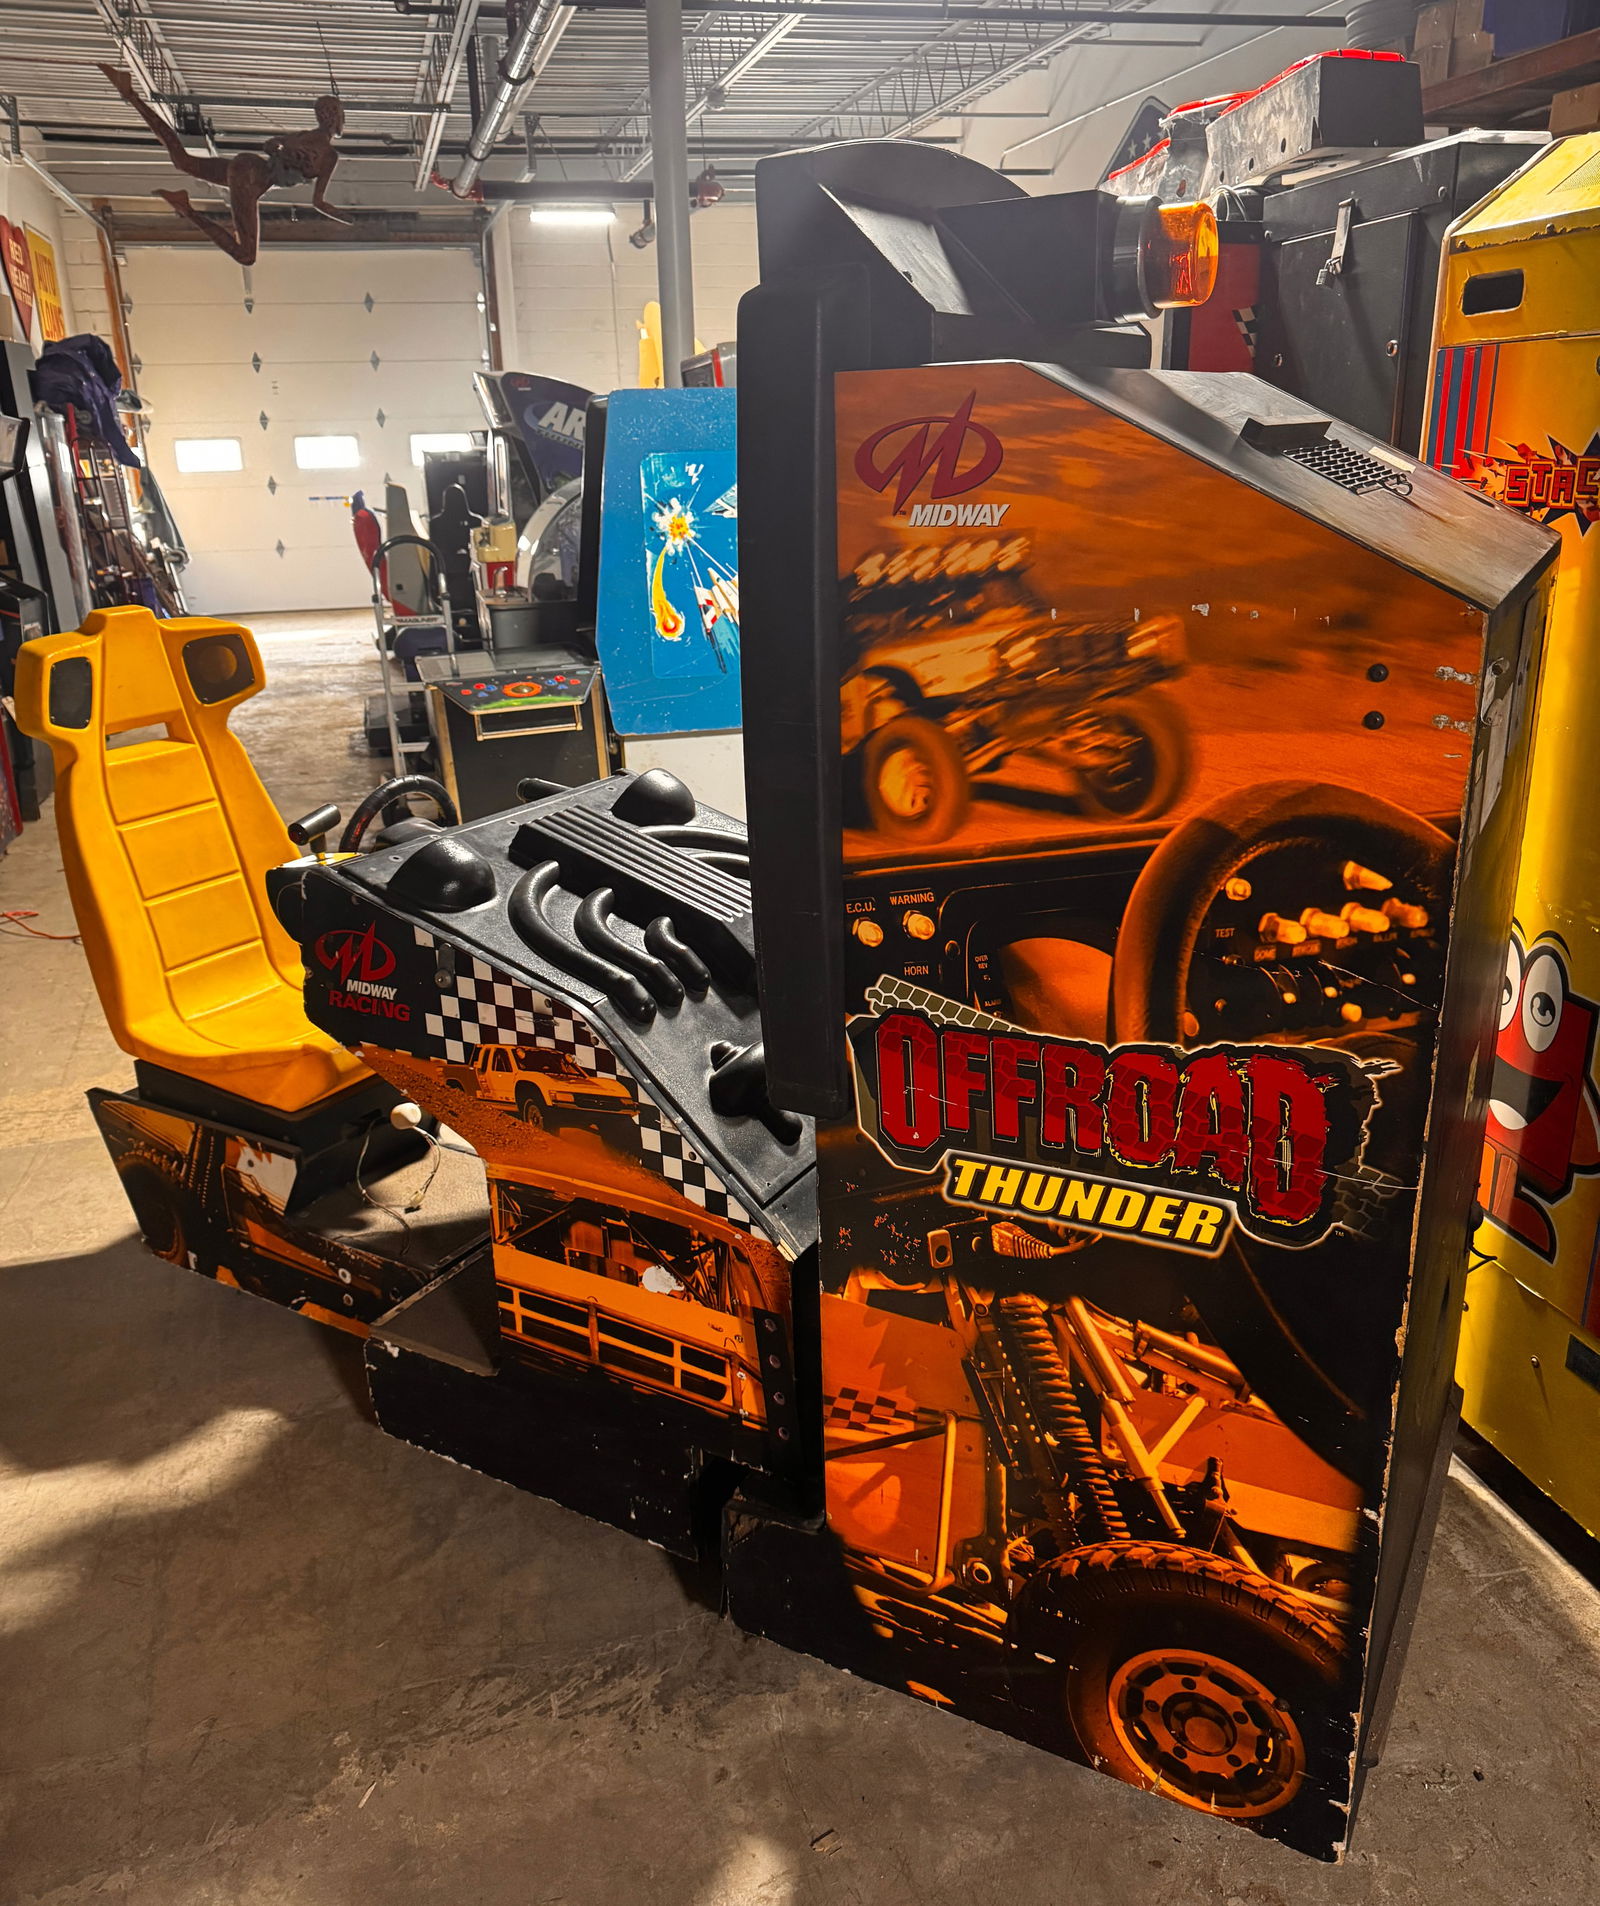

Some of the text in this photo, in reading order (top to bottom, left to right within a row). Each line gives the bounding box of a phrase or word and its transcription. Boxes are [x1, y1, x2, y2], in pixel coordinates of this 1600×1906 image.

[909, 503, 1010, 527] MIDWAY
[846, 902, 876, 914] E.C.U.
[890, 892, 935, 906] WARNING
[1216, 928, 1235, 938] TEST
[904, 965, 929, 976] HORN
[347, 979, 397, 1001] MIDWAY
[328, 990, 411, 1022] RACING
[877, 1013, 1328, 1225] OFFROAD
[953, 1159, 1224, 1246] THUNDER
